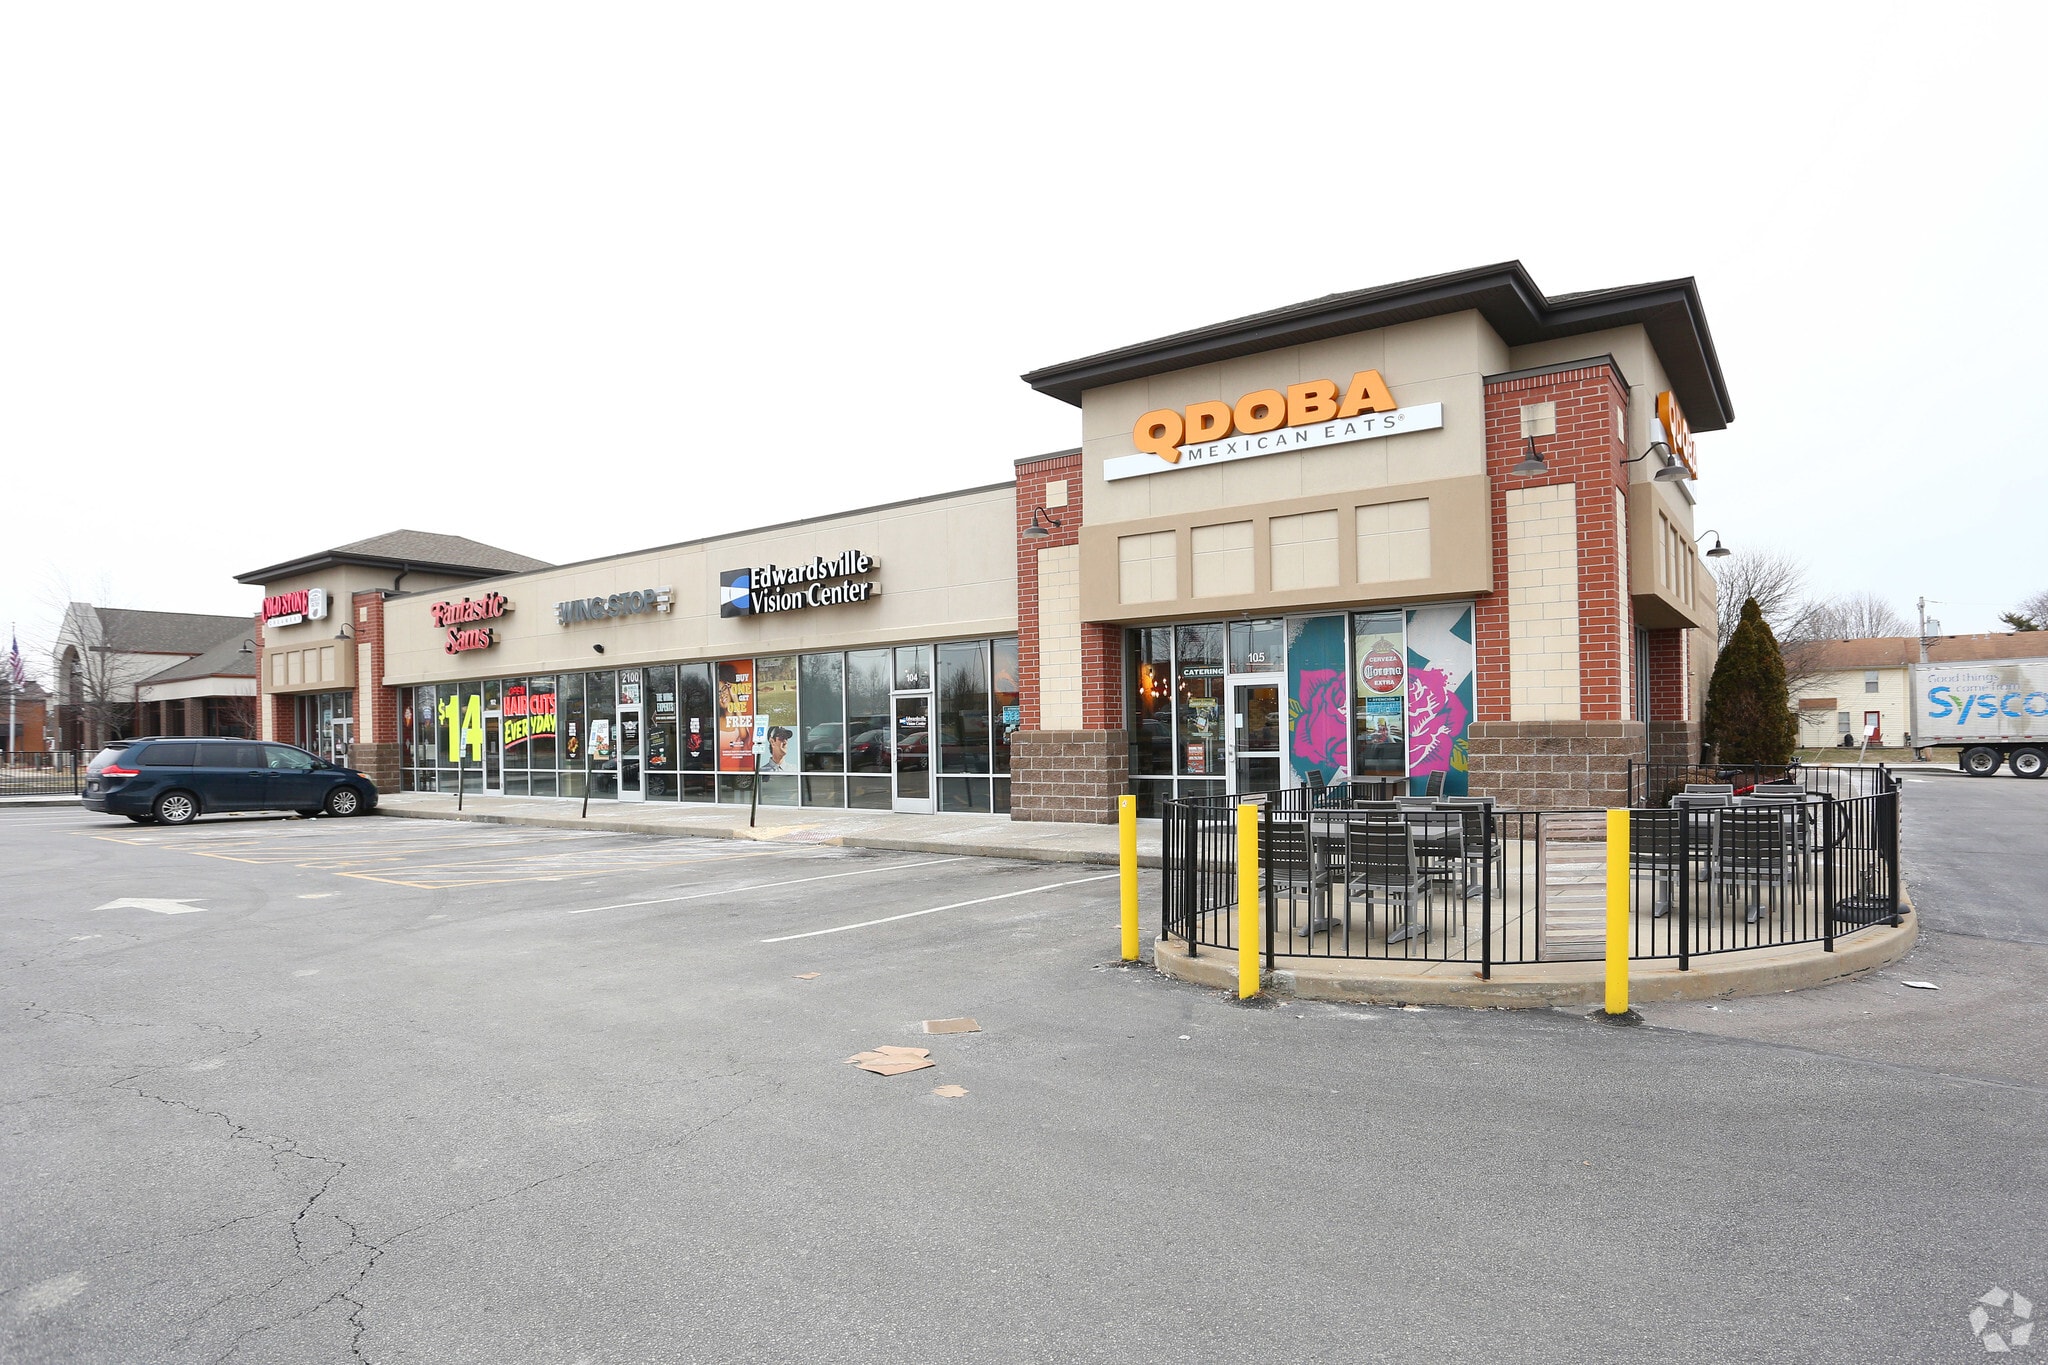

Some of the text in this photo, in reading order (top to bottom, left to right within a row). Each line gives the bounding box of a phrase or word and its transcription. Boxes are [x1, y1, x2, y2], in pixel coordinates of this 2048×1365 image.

[1133, 369, 1398, 464] QDOBA
[1188, 430, 1308, 461] MEXICAN
[751, 549, 869, 589] Edwardsville
[607, 588, 656, 618] STOP
[751, 580, 868, 614] Vision Center
[262, 596, 281, 623] COLD
[282, 589, 308, 616] STONE
[431, 591, 504, 628] Fantastic
[445, 627, 491, 654] Sams
[1248, 652, 1265, 663] 105
[1369, 655, 1398, 663] CERVEZA
[622, 672, 639, 683] 2100
[735, 674, 749, 682] BUY
[906, 673, 918, 682] 104
[1183, 668, 1224, 676] CATERING
[1363, 664, 1402, 680] Corona
[1928, 673, 2000, 684] Good things
[731, 683, 752, 694] ONE
[1956, 682, 2021, 692] come from
[727, 701, 747, 713] ONE
[726, 715, 752, 728] FREE
